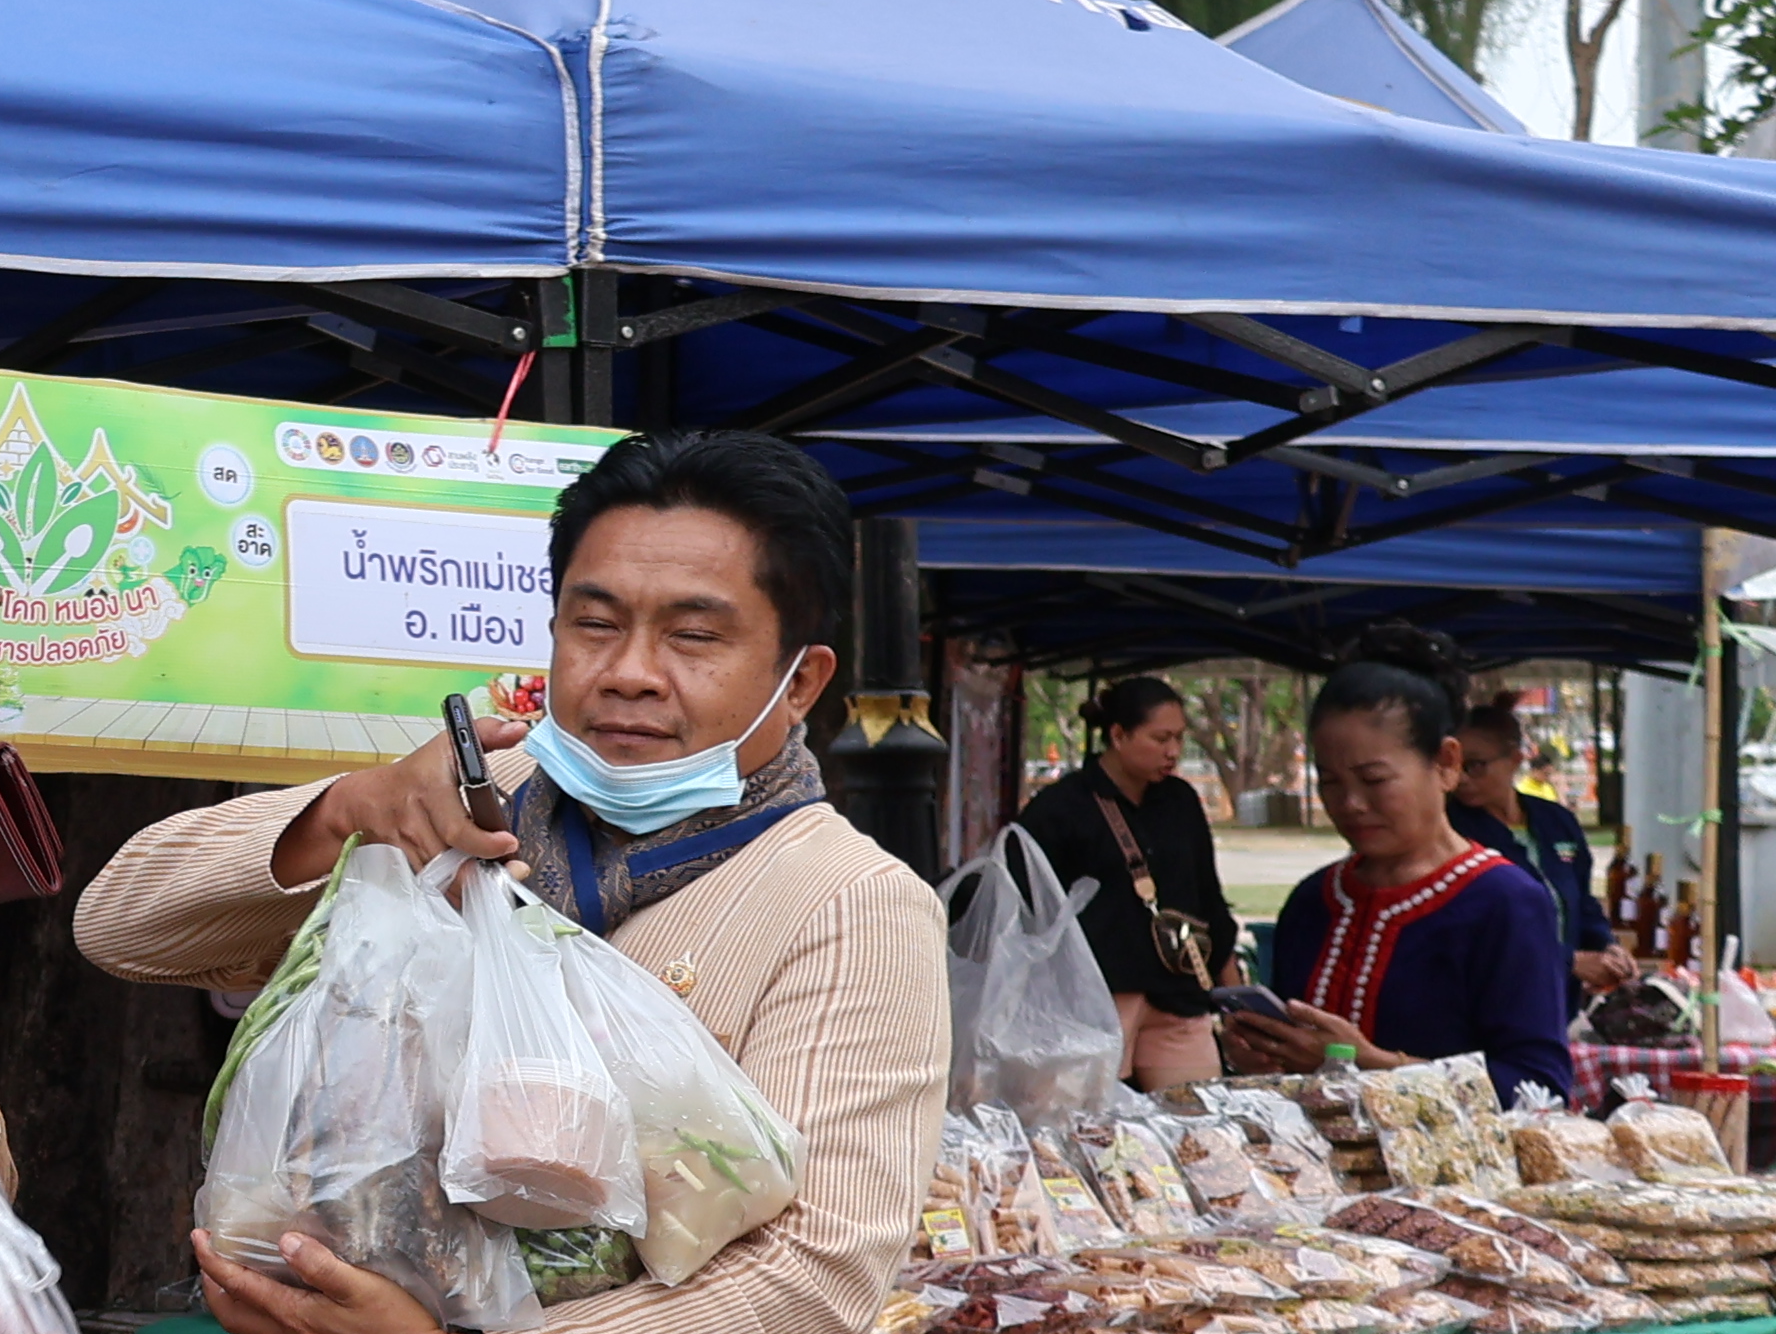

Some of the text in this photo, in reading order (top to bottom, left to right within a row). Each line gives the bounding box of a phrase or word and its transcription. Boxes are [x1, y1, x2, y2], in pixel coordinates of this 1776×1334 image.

[213, 466, 238, 484] สด
[245, 524, 265, 539] สะ
[237, 539, 273, 557] อาด
[3, 590, 47, 618] โคก
[55, 598, 119, 617] หนอง
[126, 585, 159, 611] นา
[405, 602, 525, 646] อ. เมือง
